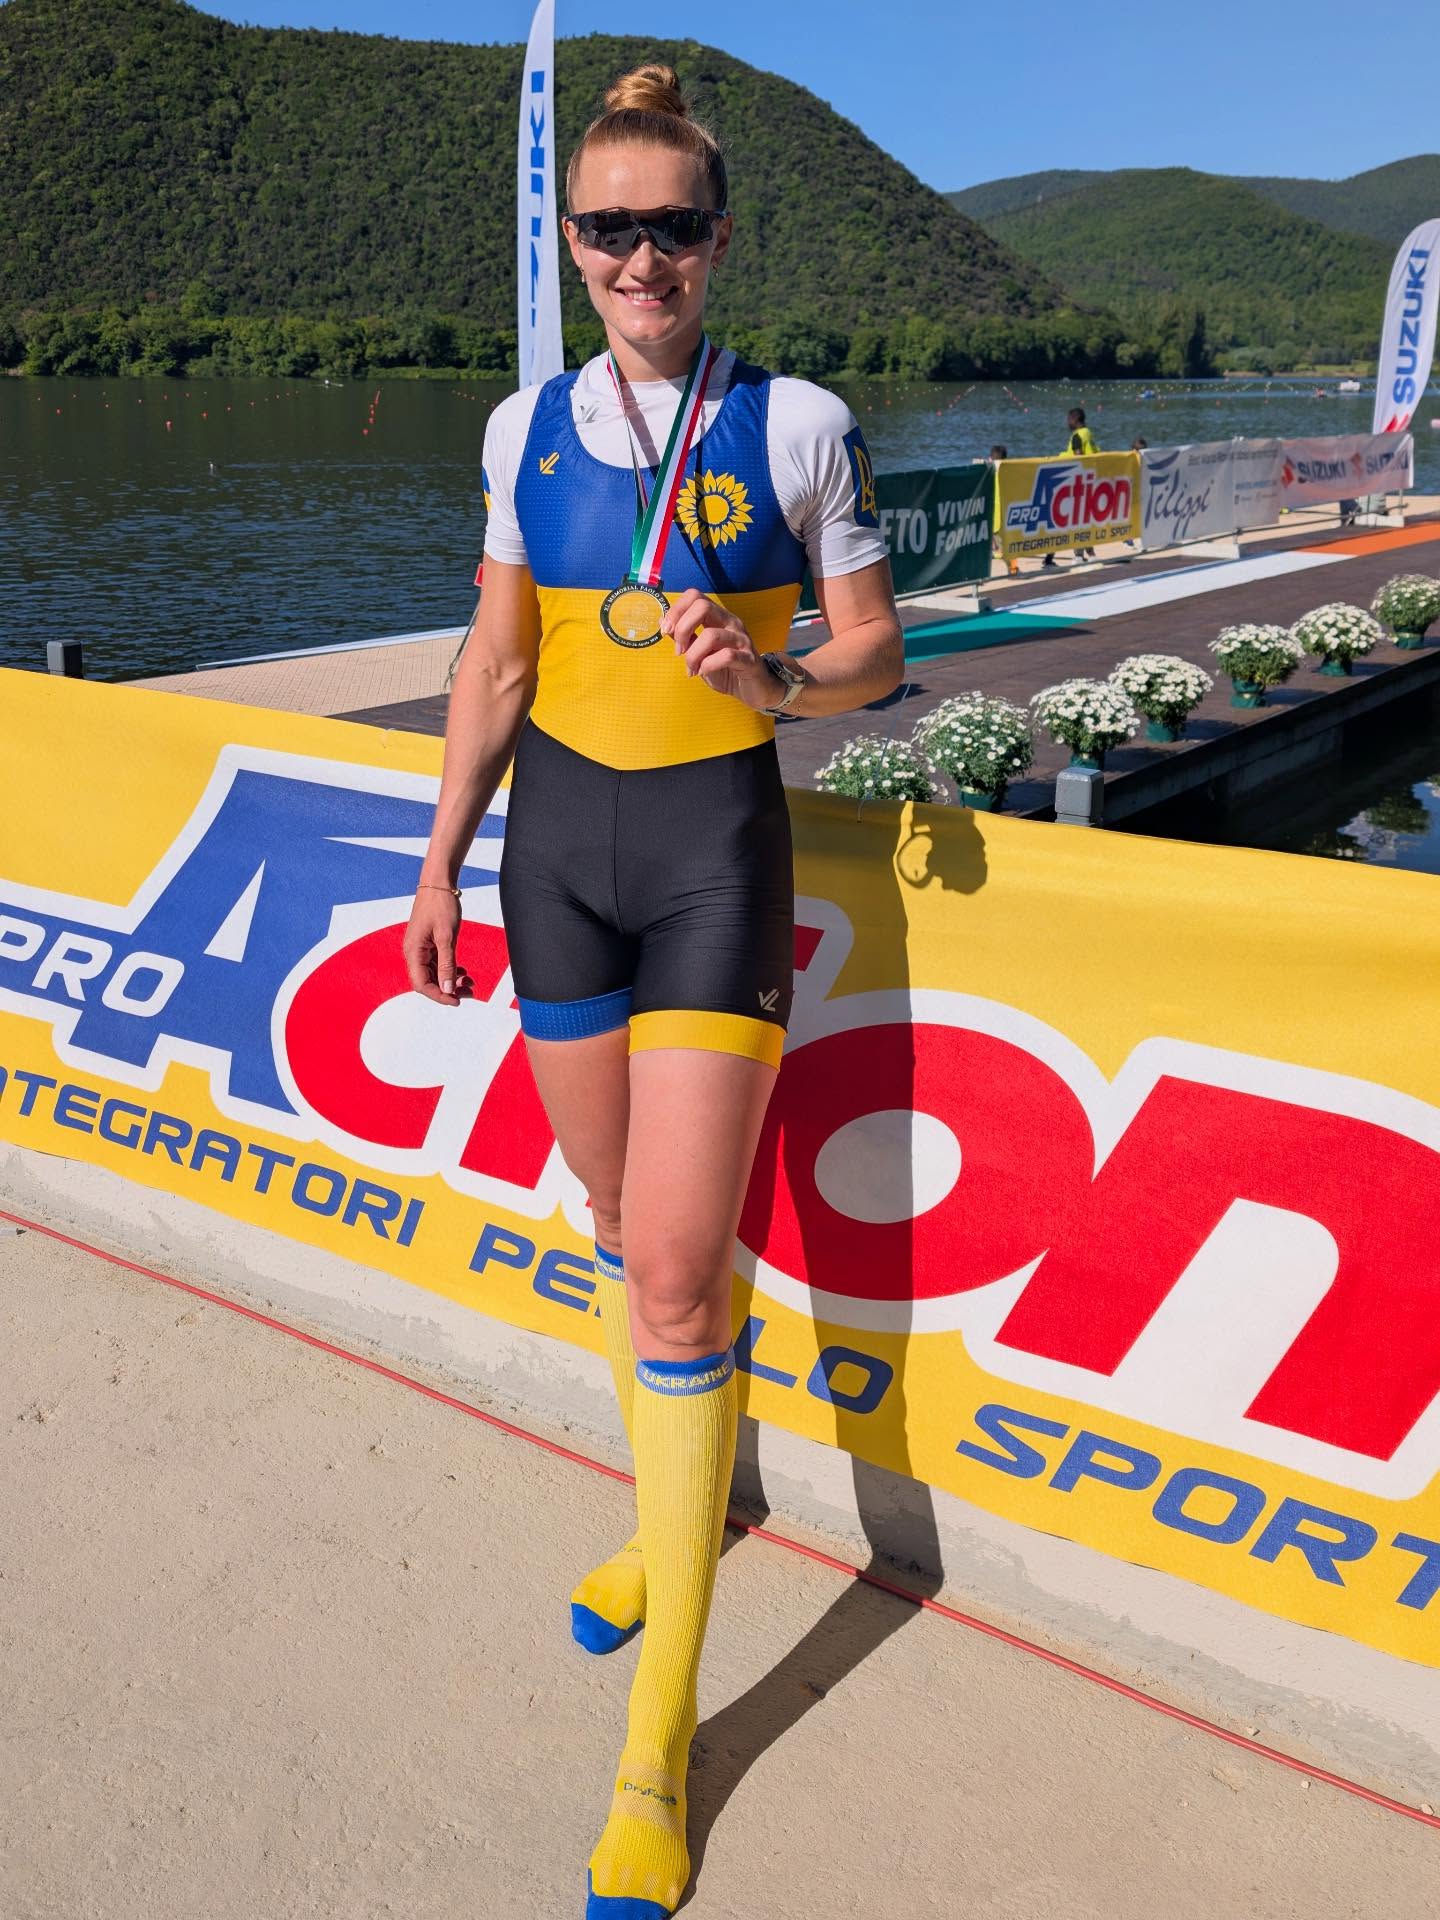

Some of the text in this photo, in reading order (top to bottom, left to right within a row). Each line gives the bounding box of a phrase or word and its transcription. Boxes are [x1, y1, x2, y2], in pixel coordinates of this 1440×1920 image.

[1393, 248, 1430, 405] SUZUKI
[1024, 464, 1132, 533] Action
[1145, 450, 1214, 540] Filippi
[1297, 460, 1347, 481] SUZUKI
[934, 520, 990, 556] FORMA
[1008, 525, 1133, 553] INTEGRATORI PER LO SPORT
[1009, 507, 1041, 524] PRO
[608, 585, 639, 604] MEMORIAL
[640, 585, 661, 599] PAOLO
[0, 919, 185, 1018] PRO
[68, 768, 1440, 1462] Acon
[0, 1065, 426, 1247] TEGRATORI
[468, 1223, 602, 1319] PE
[733, 1314, 895, 1415] LO
[642, 1360, 730, 1388] UKRAINE
